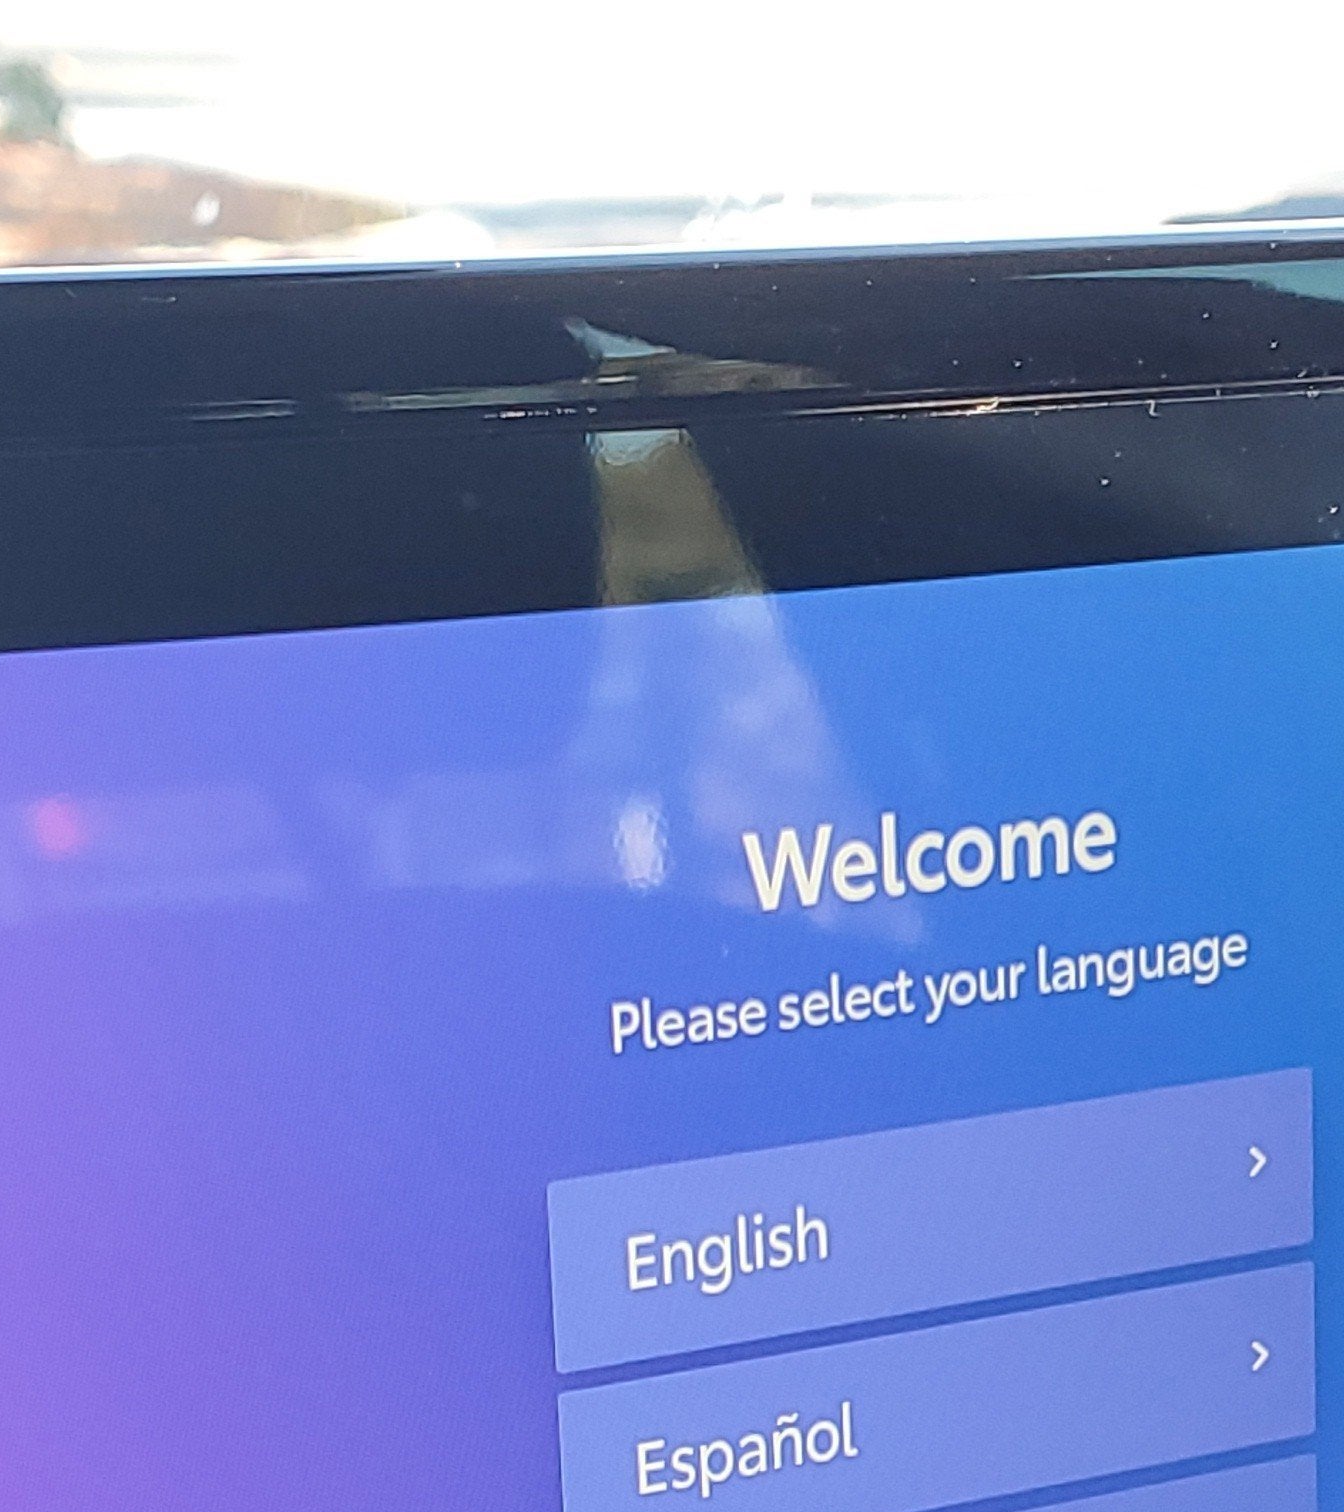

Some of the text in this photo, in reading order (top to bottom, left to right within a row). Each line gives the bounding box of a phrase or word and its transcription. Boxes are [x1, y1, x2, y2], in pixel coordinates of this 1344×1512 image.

[741, 811, 1118, 912] Welcome
[610, 932, 1249, 1055] Please select your language
[627, 1204, 829, 1296] English
[635, 1400, 859, 1499] Español
